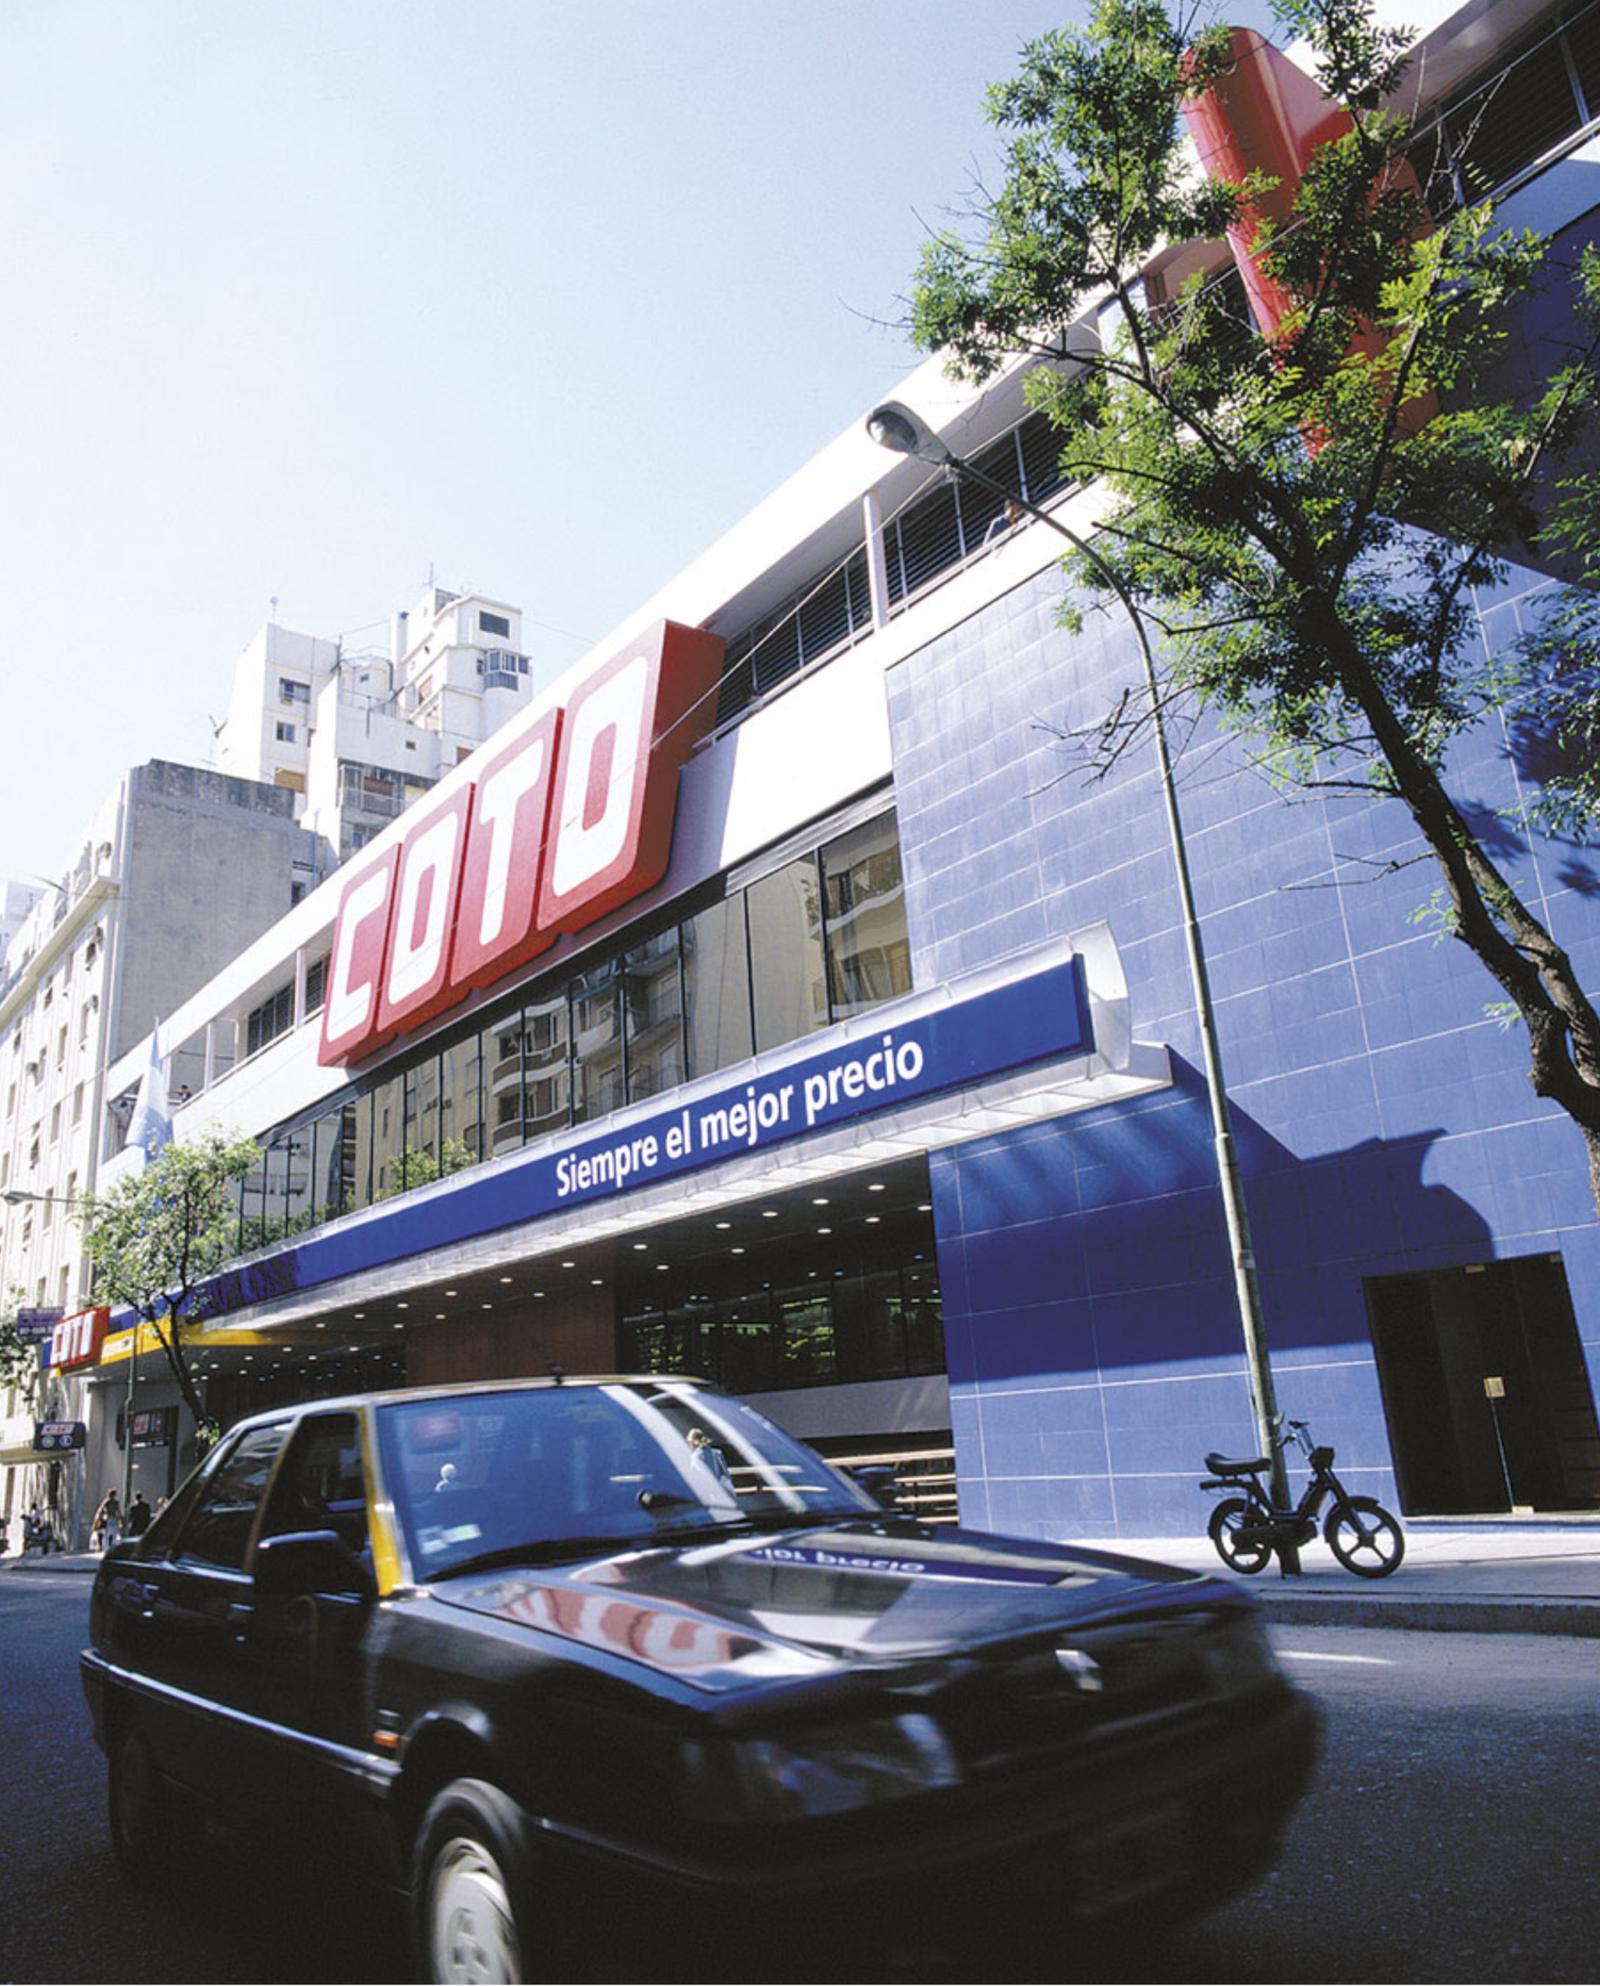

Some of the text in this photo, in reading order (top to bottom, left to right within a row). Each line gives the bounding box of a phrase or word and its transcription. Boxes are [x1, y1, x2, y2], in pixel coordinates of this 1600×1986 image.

[326, 656, 648, 1043] COTO
[556, 1034, 924, 1197] Siempre el mejor precio
